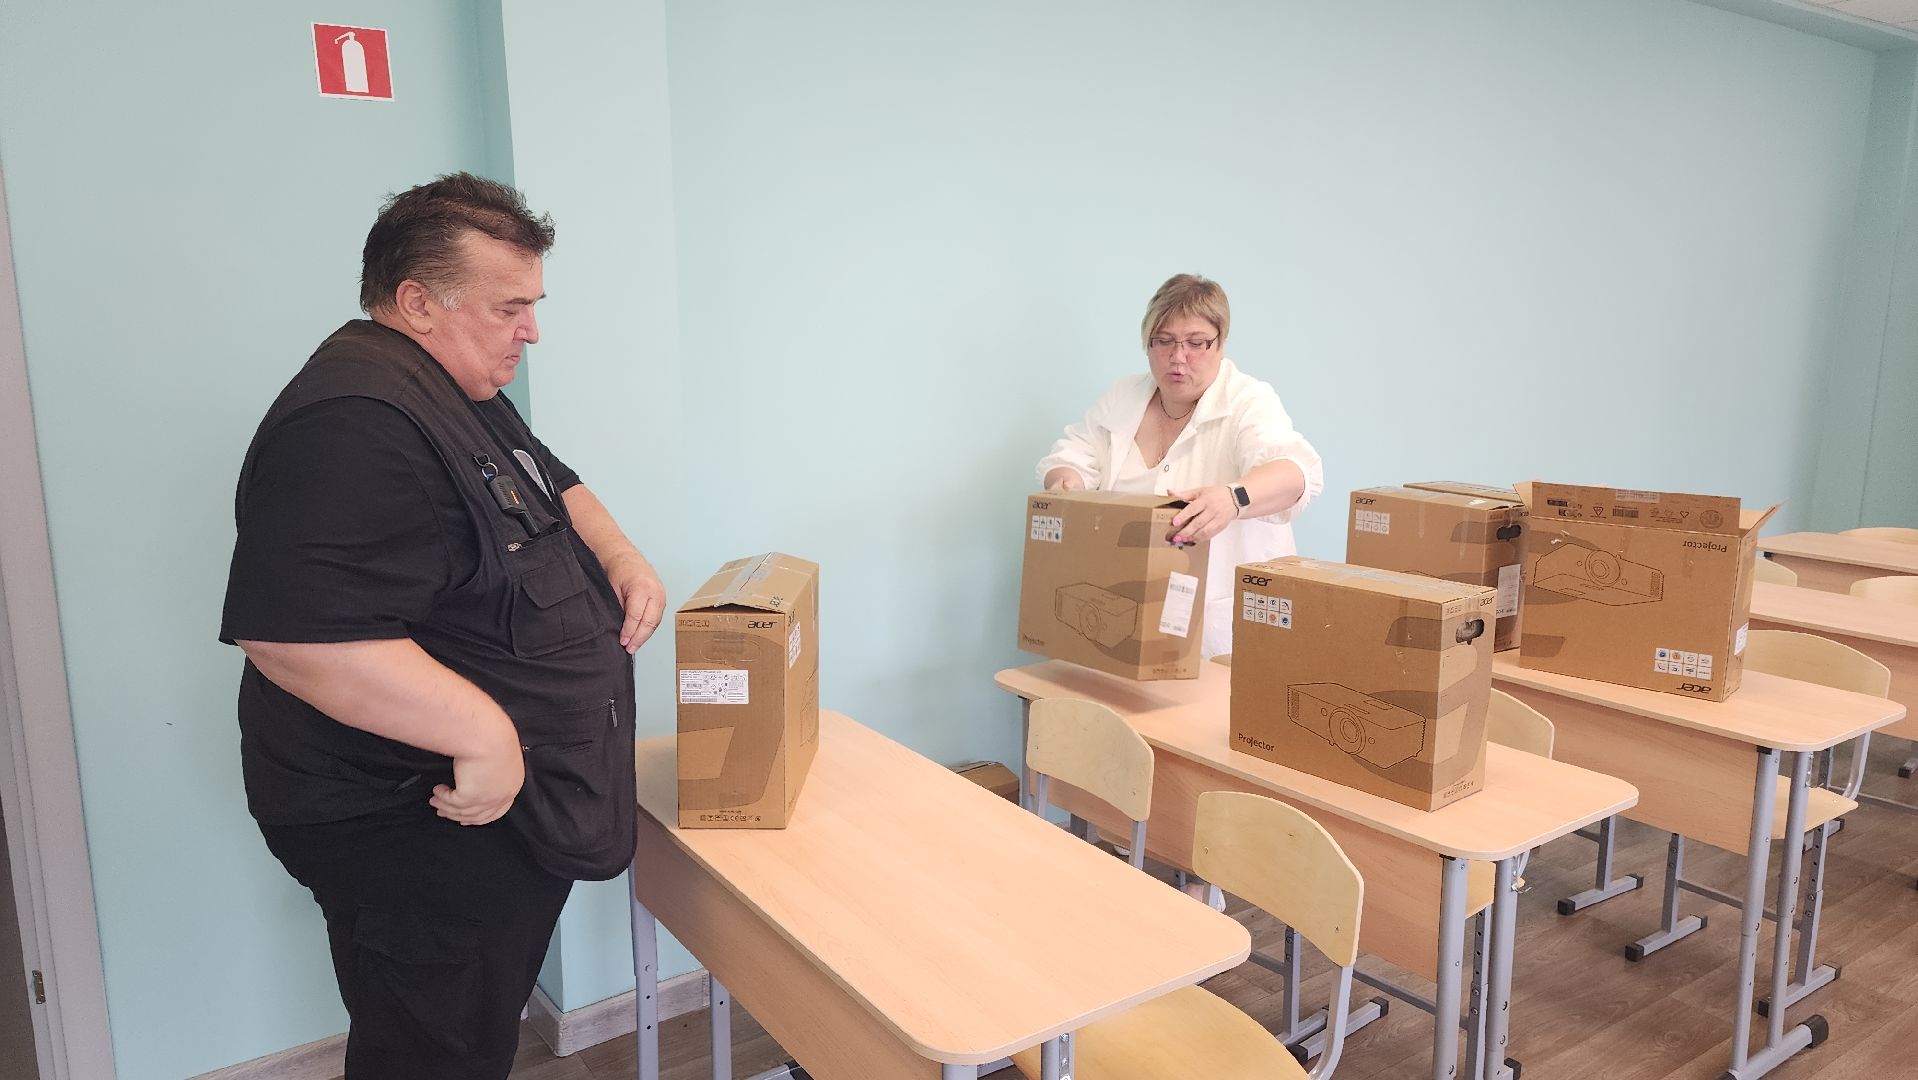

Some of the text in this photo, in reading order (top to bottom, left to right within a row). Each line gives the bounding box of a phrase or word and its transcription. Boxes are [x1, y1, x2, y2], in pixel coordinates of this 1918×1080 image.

[1032, 501, 1051, 510] acer
[1355, 497, 1377, 505] acer
[1682, 540, 1728, 553] Projector
[1242, 574, 1273, 587] acer
[1479, 596, 1495, 607] acer
[747, 620, 777, 629] acer
[1676, 682, 1712, 694] acer
[1238, 732, 1275, 751] Projector
